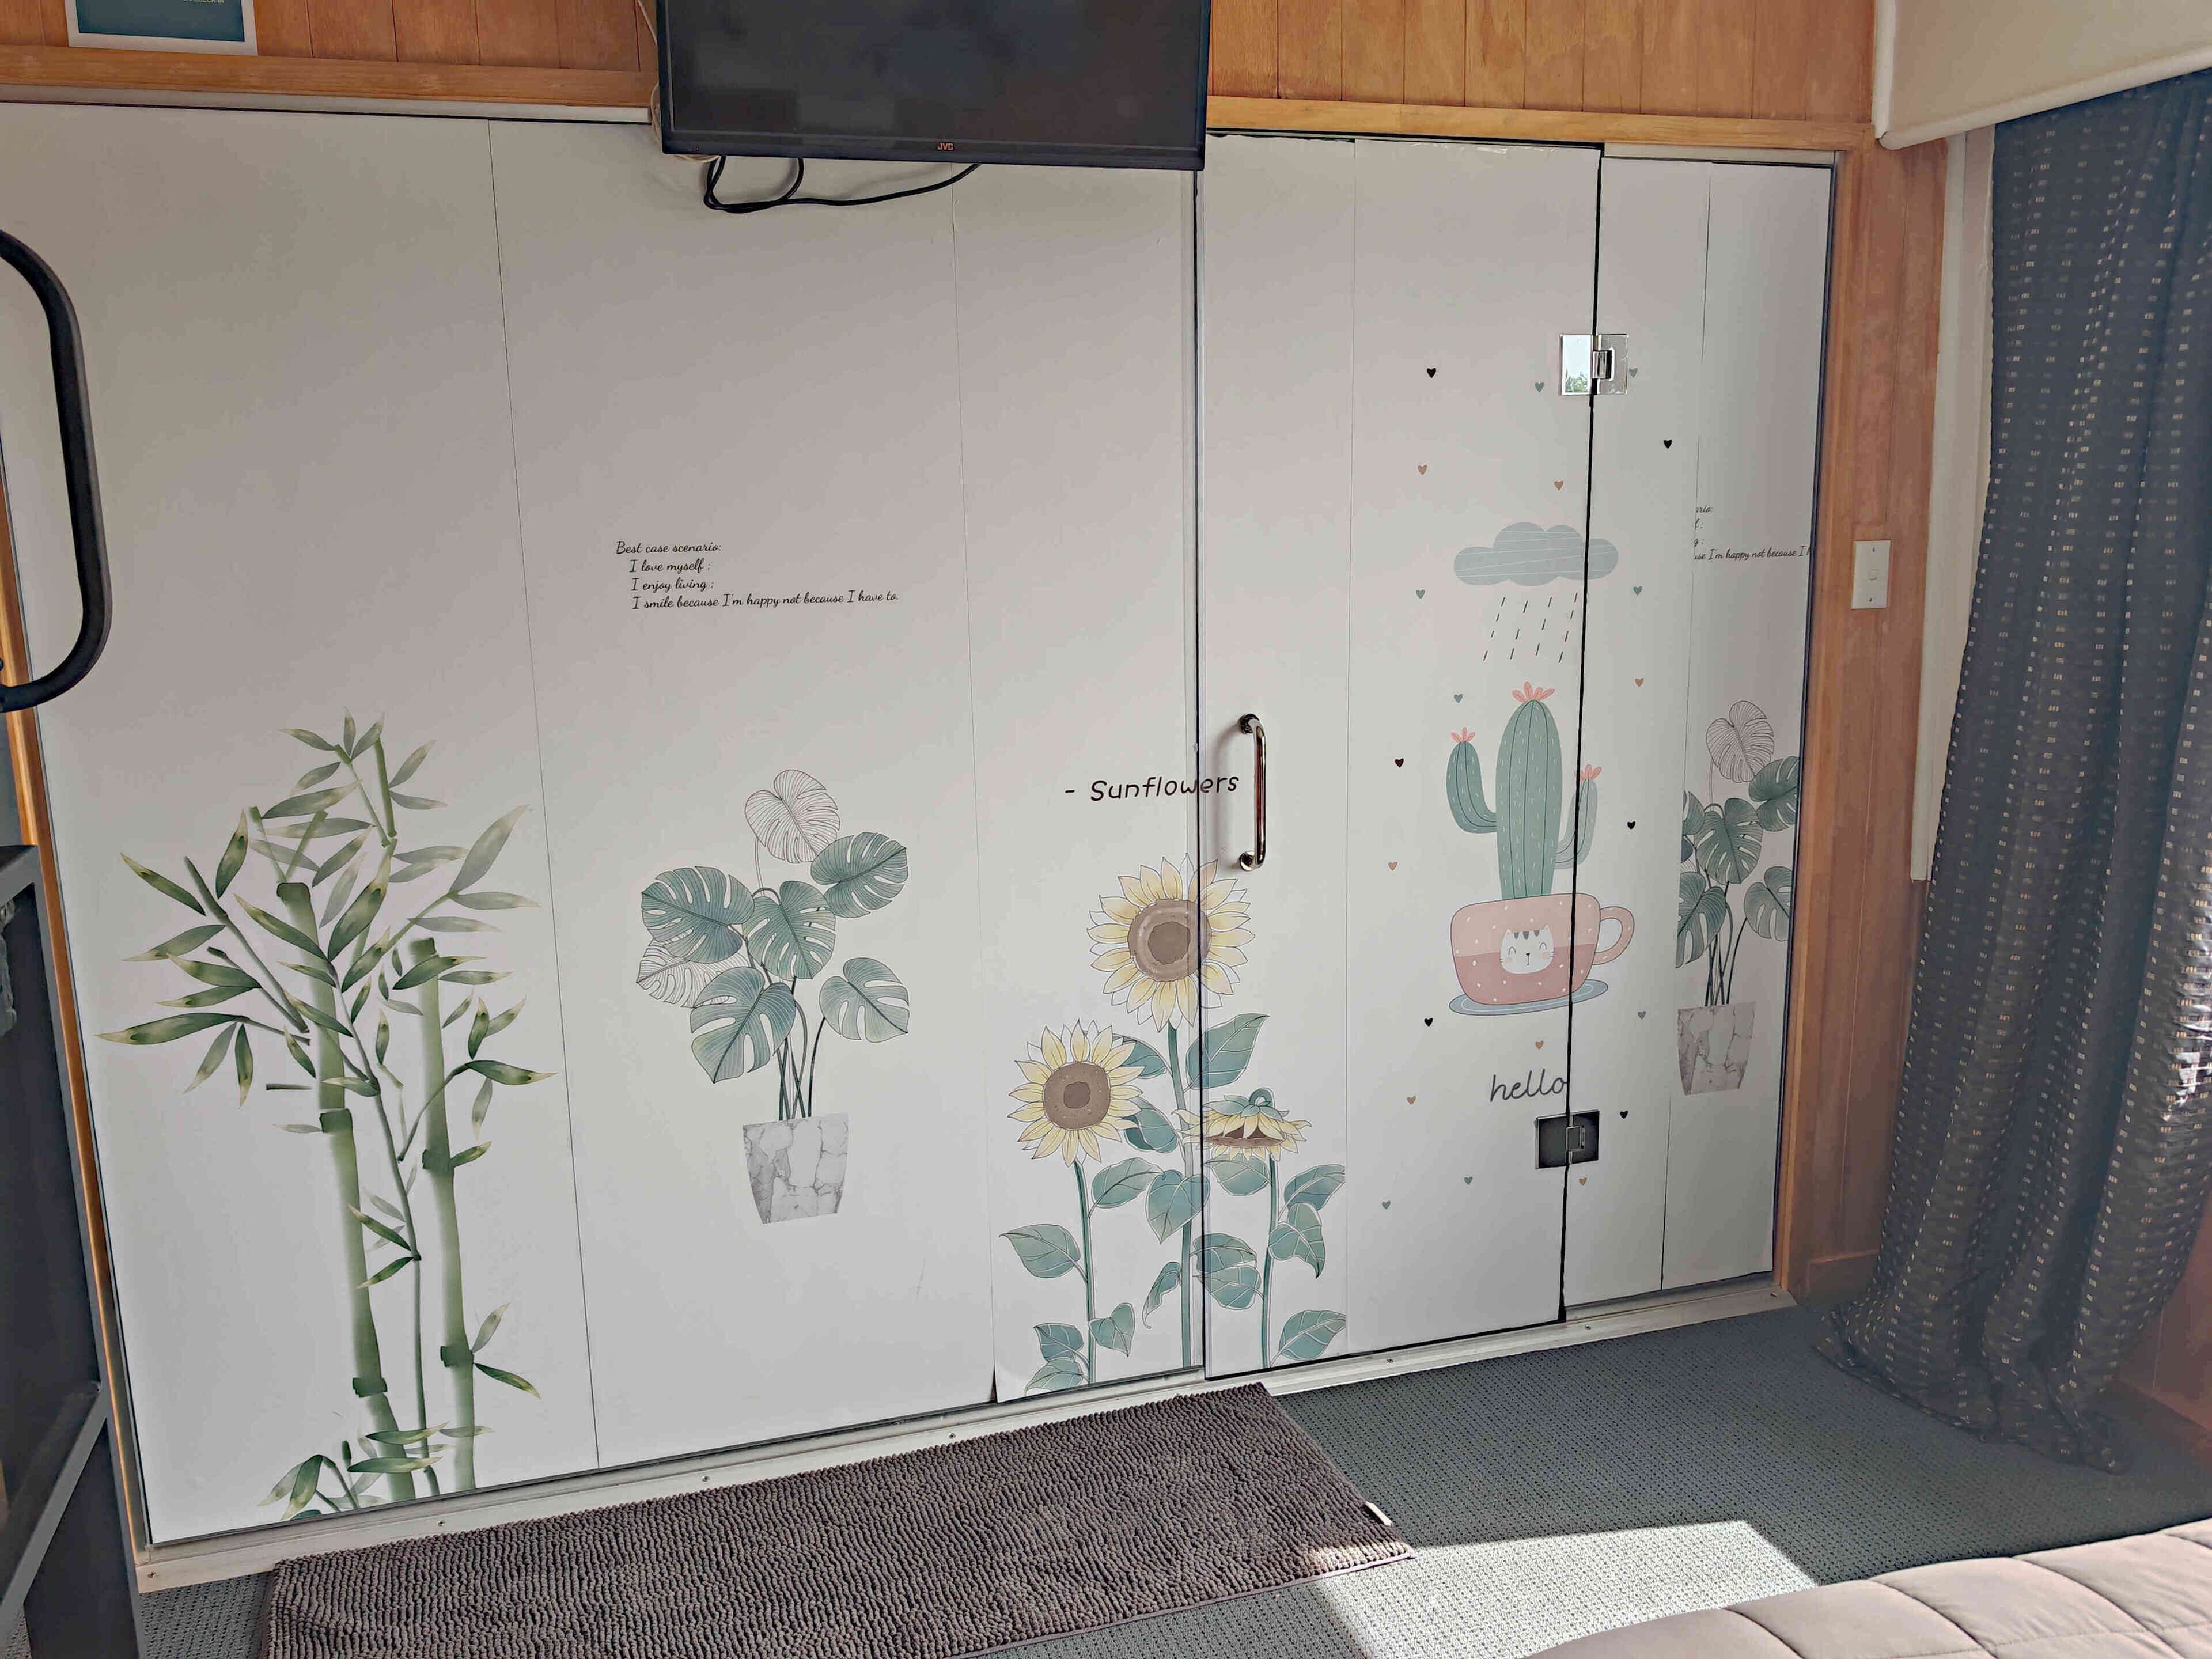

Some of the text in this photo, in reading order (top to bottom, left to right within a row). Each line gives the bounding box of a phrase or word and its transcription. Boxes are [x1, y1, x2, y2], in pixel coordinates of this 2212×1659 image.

[937, 142, 954, 150] JVC
[616, 541, 642, 554] Best
[645, 544, 669, 553] case
[1725, 548, 1749, 561] happy
[1752, 548, 1766, 558] not
[1767, 547, 1797, 558] because
[1798, 545, 1806, 556] I
[629, 559, 639, 573] I
[641, 559, 664, 571] love
[631, 578, 639, 591] I
[642, 580, 672, 593] enjoy
[632, 596, 641, 609] I
[644, 595, 674, 608] smile
[677, 595, 719, 608] because
[722, 593, 743, 607] I'm
[747, 593, 779, 609] happy
[782, 593, 802, 604] not
[804, 592, 844, 604] because
[847, 589, 856, 603] I
[858, 589, 884, 602] have
[1090, 776, 1240, 801] Sunflowers
[1490, 1068, 1567, 1103] hello
